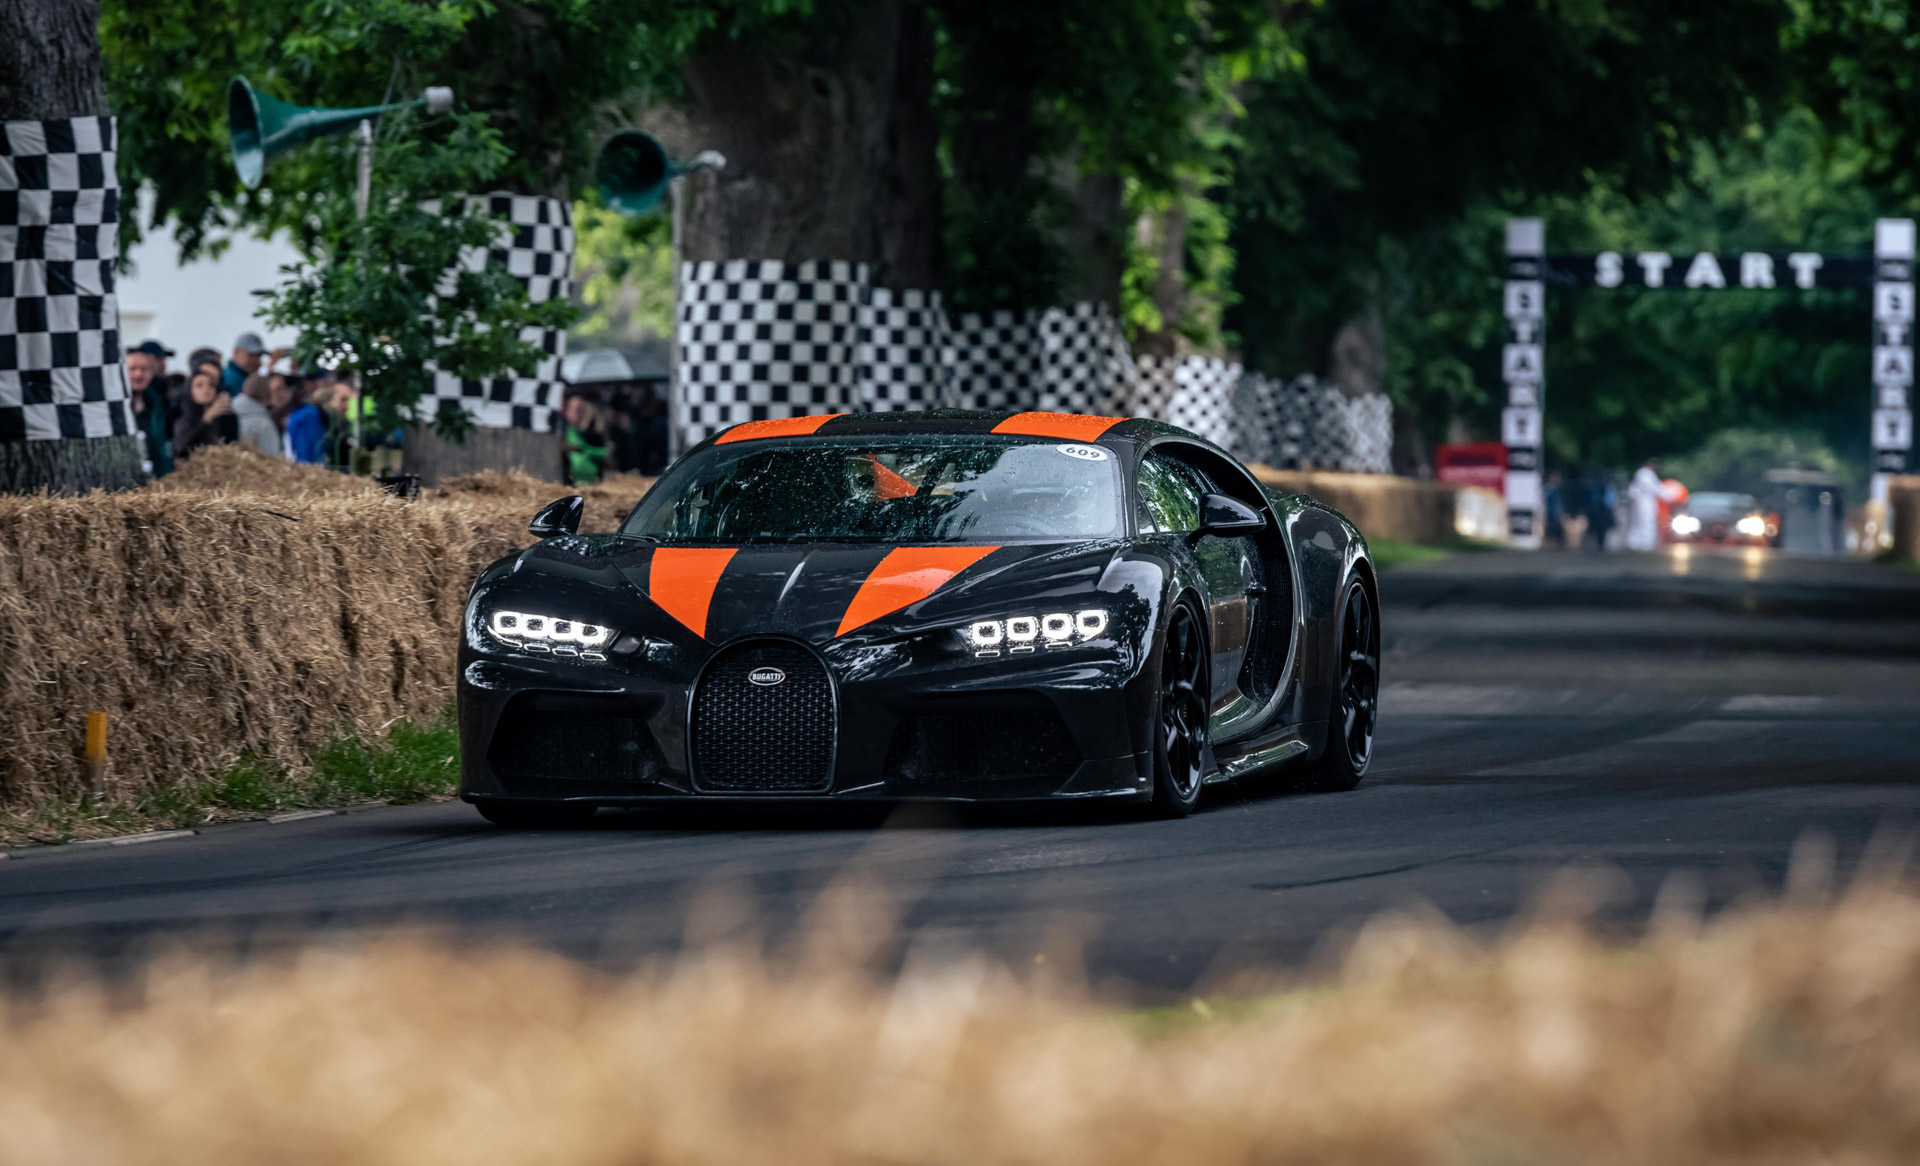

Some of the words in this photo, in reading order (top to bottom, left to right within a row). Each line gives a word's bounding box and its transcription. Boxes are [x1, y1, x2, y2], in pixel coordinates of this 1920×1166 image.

[1595, 251, 1823, 288] START
[1065, 446, 1100, 458] 609
[752, 672, 781, 680] BUGATTI
